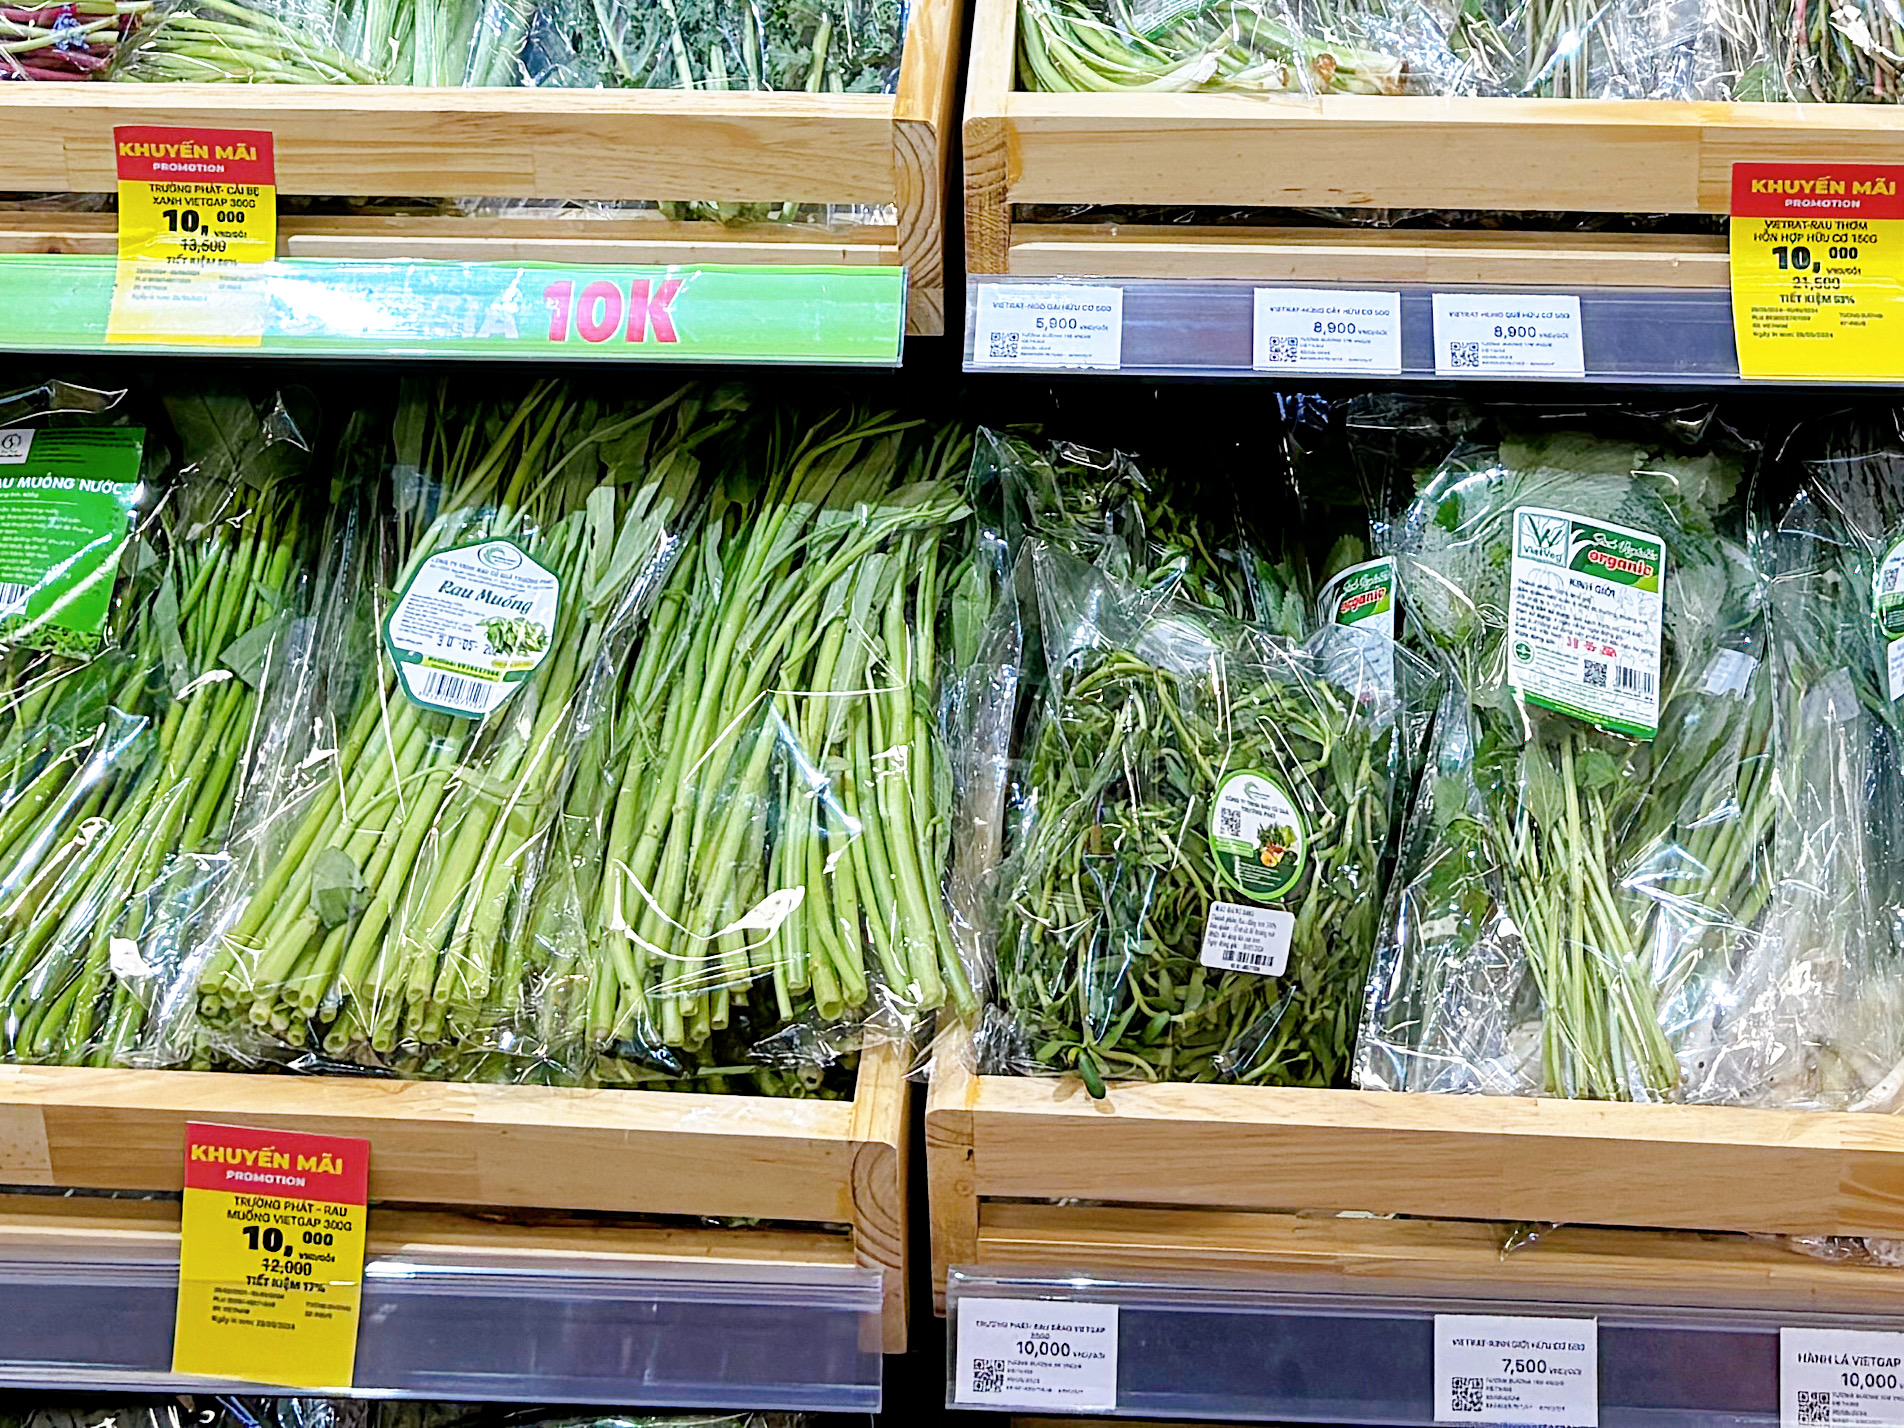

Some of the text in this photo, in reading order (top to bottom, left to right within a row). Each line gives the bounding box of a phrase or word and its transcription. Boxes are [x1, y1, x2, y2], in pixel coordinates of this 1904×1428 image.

[118, 139, 257, 161] KHUYẾN MÃI
[1751, 174, 1895, 196] KHUYẾN MÃI
[541, 276, 684, 345] 10K
[1313, 321, 1356, 336] 8,900
[17, 472, 76, 490] MUỐNG
[438, 580, 534, 615] Rau Muống
[190, 1143, 344, 1176] KHUYẾN MÃI
[225, 1169, 307, 1187] PROMOTION
[302, 1230, 334, 1248] 000
[1016, 1340, 1071, 1359] 10,000
[1840, 1372, 1897, 1391] 10,000
